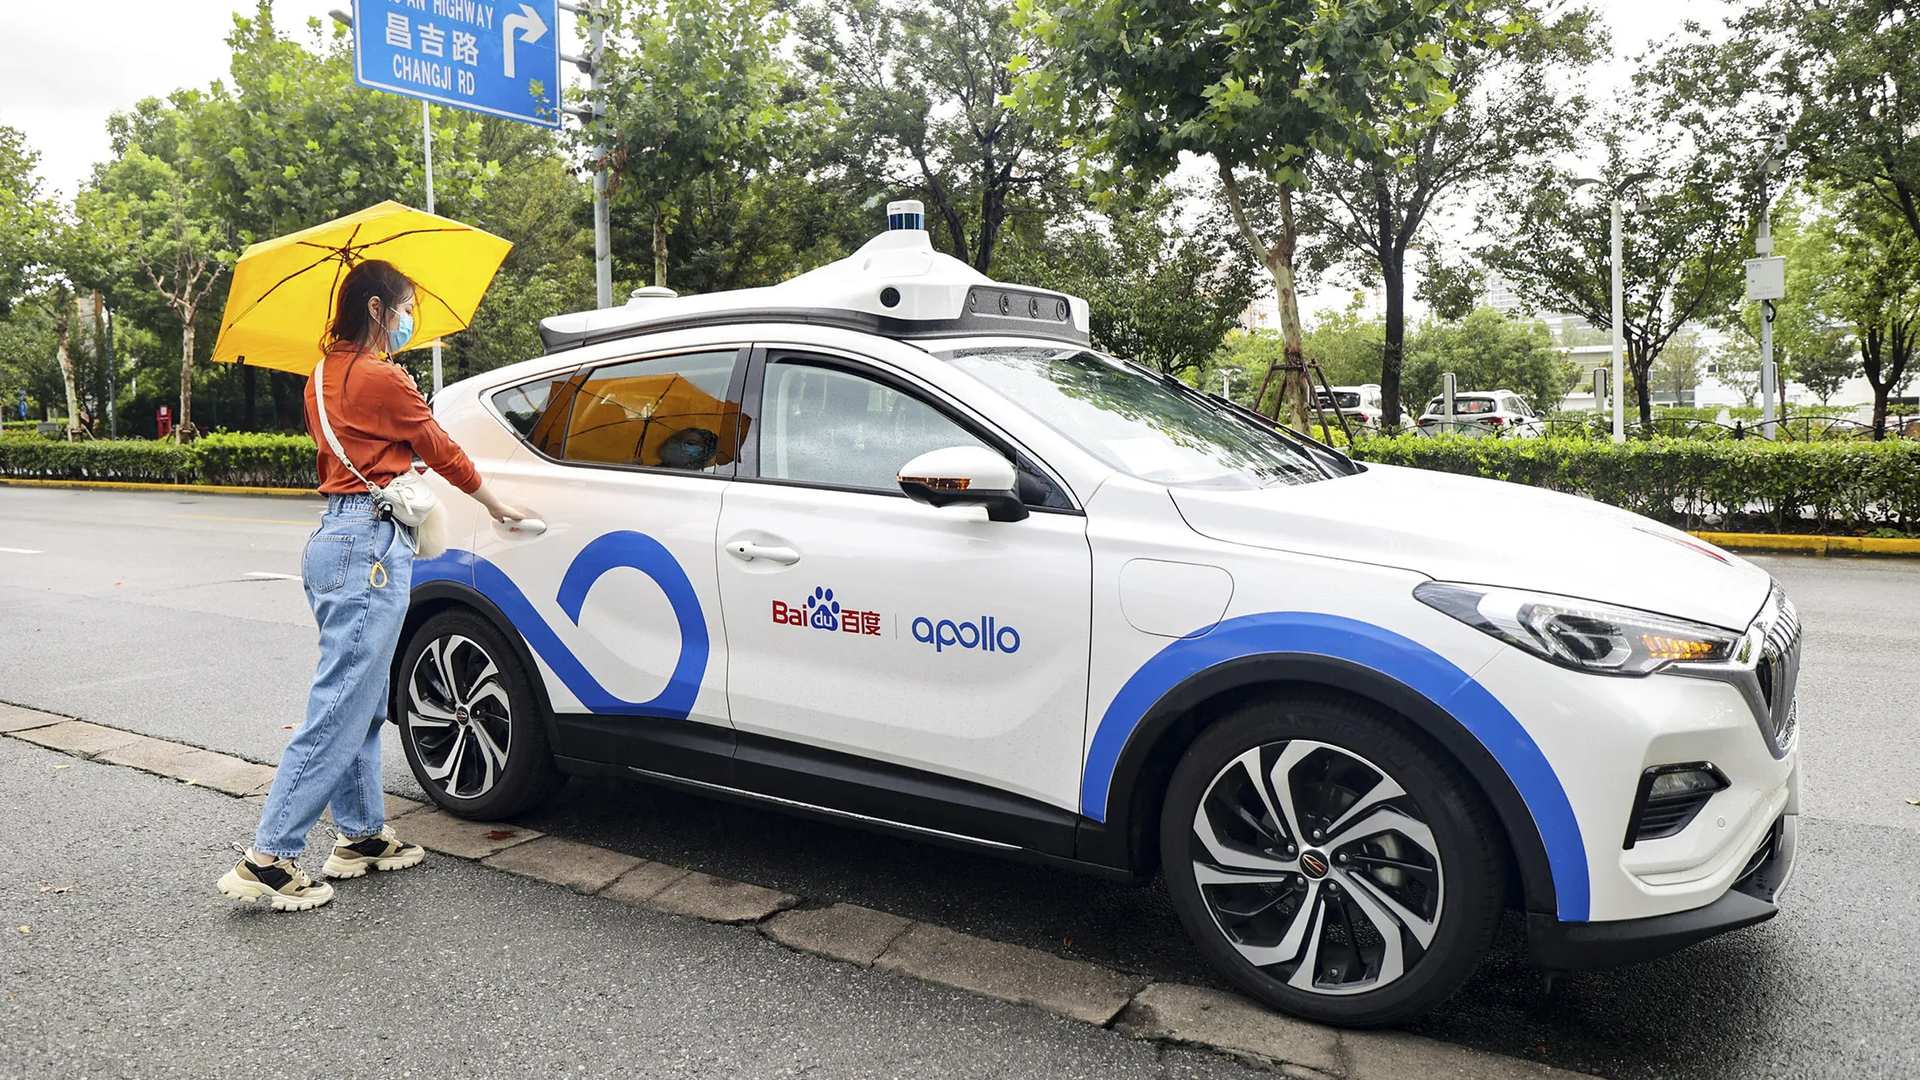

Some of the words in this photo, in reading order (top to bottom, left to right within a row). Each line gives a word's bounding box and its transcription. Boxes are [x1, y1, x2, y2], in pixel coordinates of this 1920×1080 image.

[433, 0, 494, 30] HIGHWAY
[385, 11, 480, 67] 昌吉路
[393, 54, 452, 91] CHANGJI
[458, 69, 475, 96] RD
[911, 615, 1021, 654] apollo
